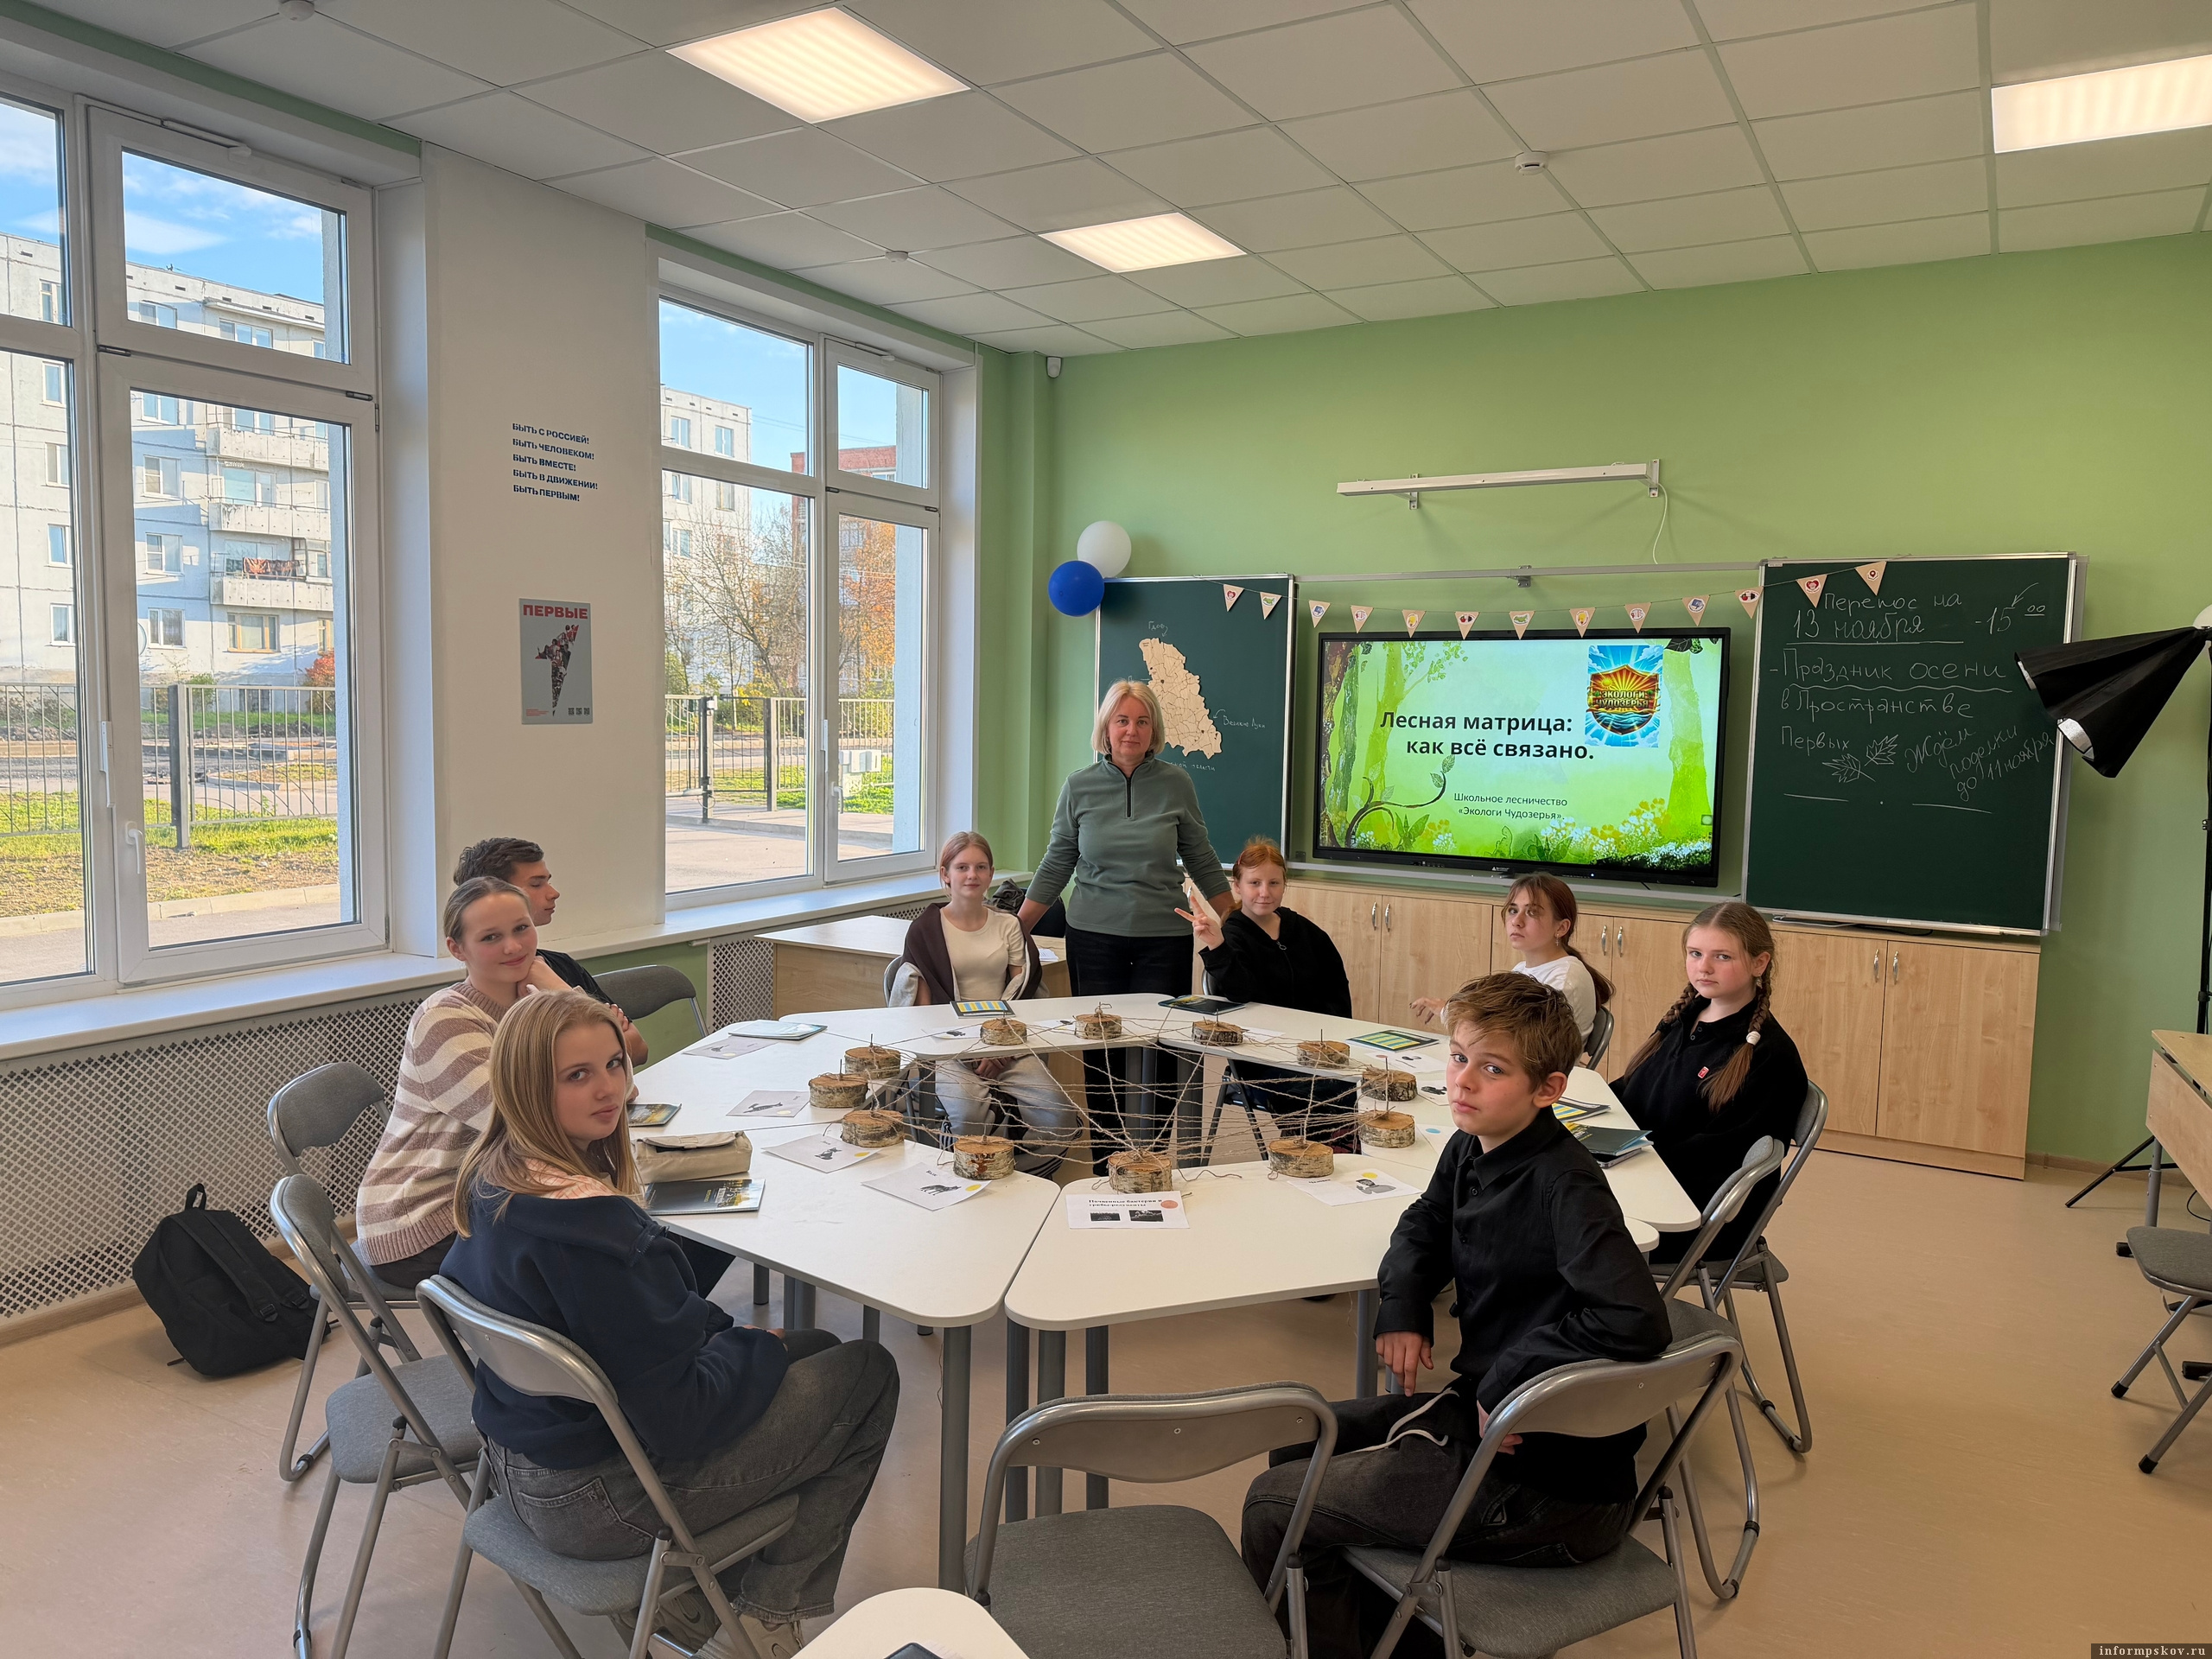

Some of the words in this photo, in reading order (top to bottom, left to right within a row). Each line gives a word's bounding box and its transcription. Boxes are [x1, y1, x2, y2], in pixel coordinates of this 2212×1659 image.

[512, 423, 537, 435] БЫТЬ
[546, 429, 589, 444] РОССИЕЙ!
[512, 438, 537, 449] БЫТЬ
[538, 443, 594, 460] ЧЕЛОВЕКОМ!
[512, 454, 538, 465] БЫТЬ
[539, 458, 576, 472] ВМЕСТЕ!
[512, 469, 538, 480] БЫТЬ
[546, 475, 599, 490] ДВИЖЕНИИ!
[513, 485, 538, 495] БЫТЬ
[539, 488, 581, 502] ПЕРВЫМ!
[523, 604, 588, 620] ПЕРВЫЕ
[1824, 593, 1917, 617] Перенос
[1934, 593, 1962, 607] на
[1794, 609, 1820, 638] 13
[1834, 612, 1925, 642] ноября
[1910, 662, 2006, 681] осени
[1596, 699, 1649, 709] ЧУДОЗЕРЬЯ
[1602, 690, 1645, 699] ЭКОЛОГИ
[1796, 690, 1974, 724] Пространстве
[1380, 711, 1456, 730] Лесная
[1463, 716, 1573, 735] матрица:
[1407, 741, 1444, 754] как
[1451, 739, 1486, 756] всё
[1493, 743, 1594, 760] связано.
[1782, 726, 1850, 756] Первых
[1454, 792, 1503, 804] Школьное
[1505, 795, 1568, 806] лесничество
[1956, 777, 1978, 802] до
[1458, 806, 1502, 817] «Экологи
